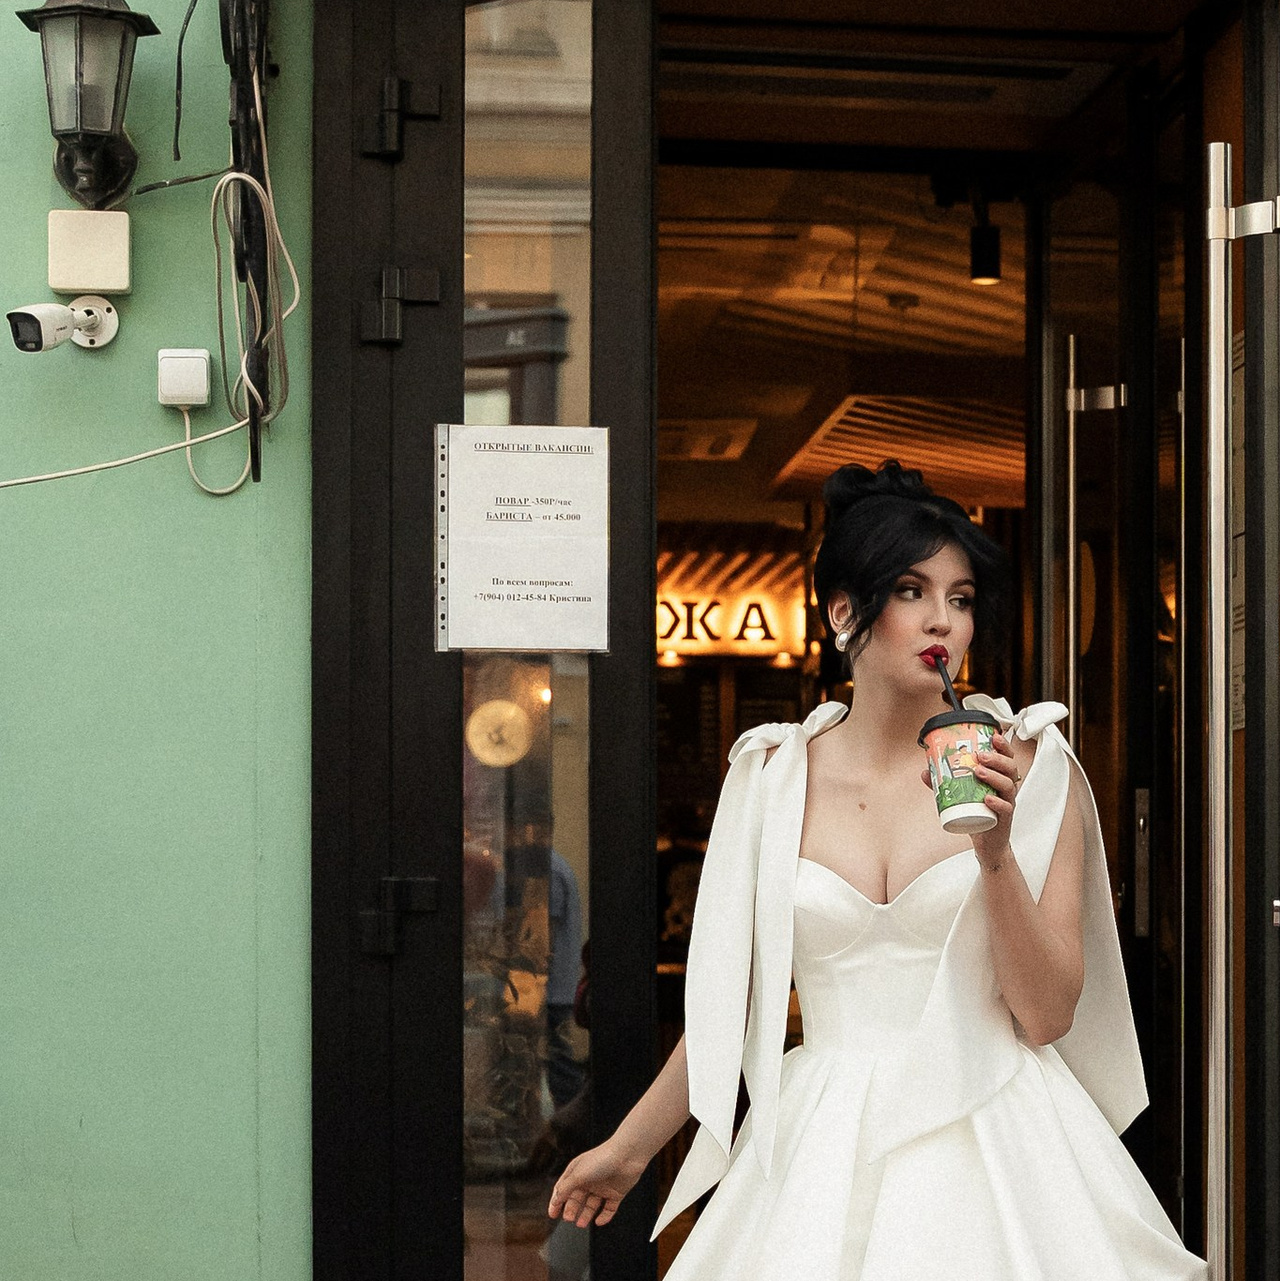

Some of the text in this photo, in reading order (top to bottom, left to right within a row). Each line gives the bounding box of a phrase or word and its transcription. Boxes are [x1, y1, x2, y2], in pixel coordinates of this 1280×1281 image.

[474, 442, 533, 453] ОТКРЫТЫЕ
[495, 496, 530, 506] ПОВАР
[486, 511, 533, 521] БАРИСТА
[492, 577, 504, 586] По
[529, 579, 574, 588] вопросам:
[549, 594, 592, 603] Кристина
[659, 600, 807, 641] ЖА
